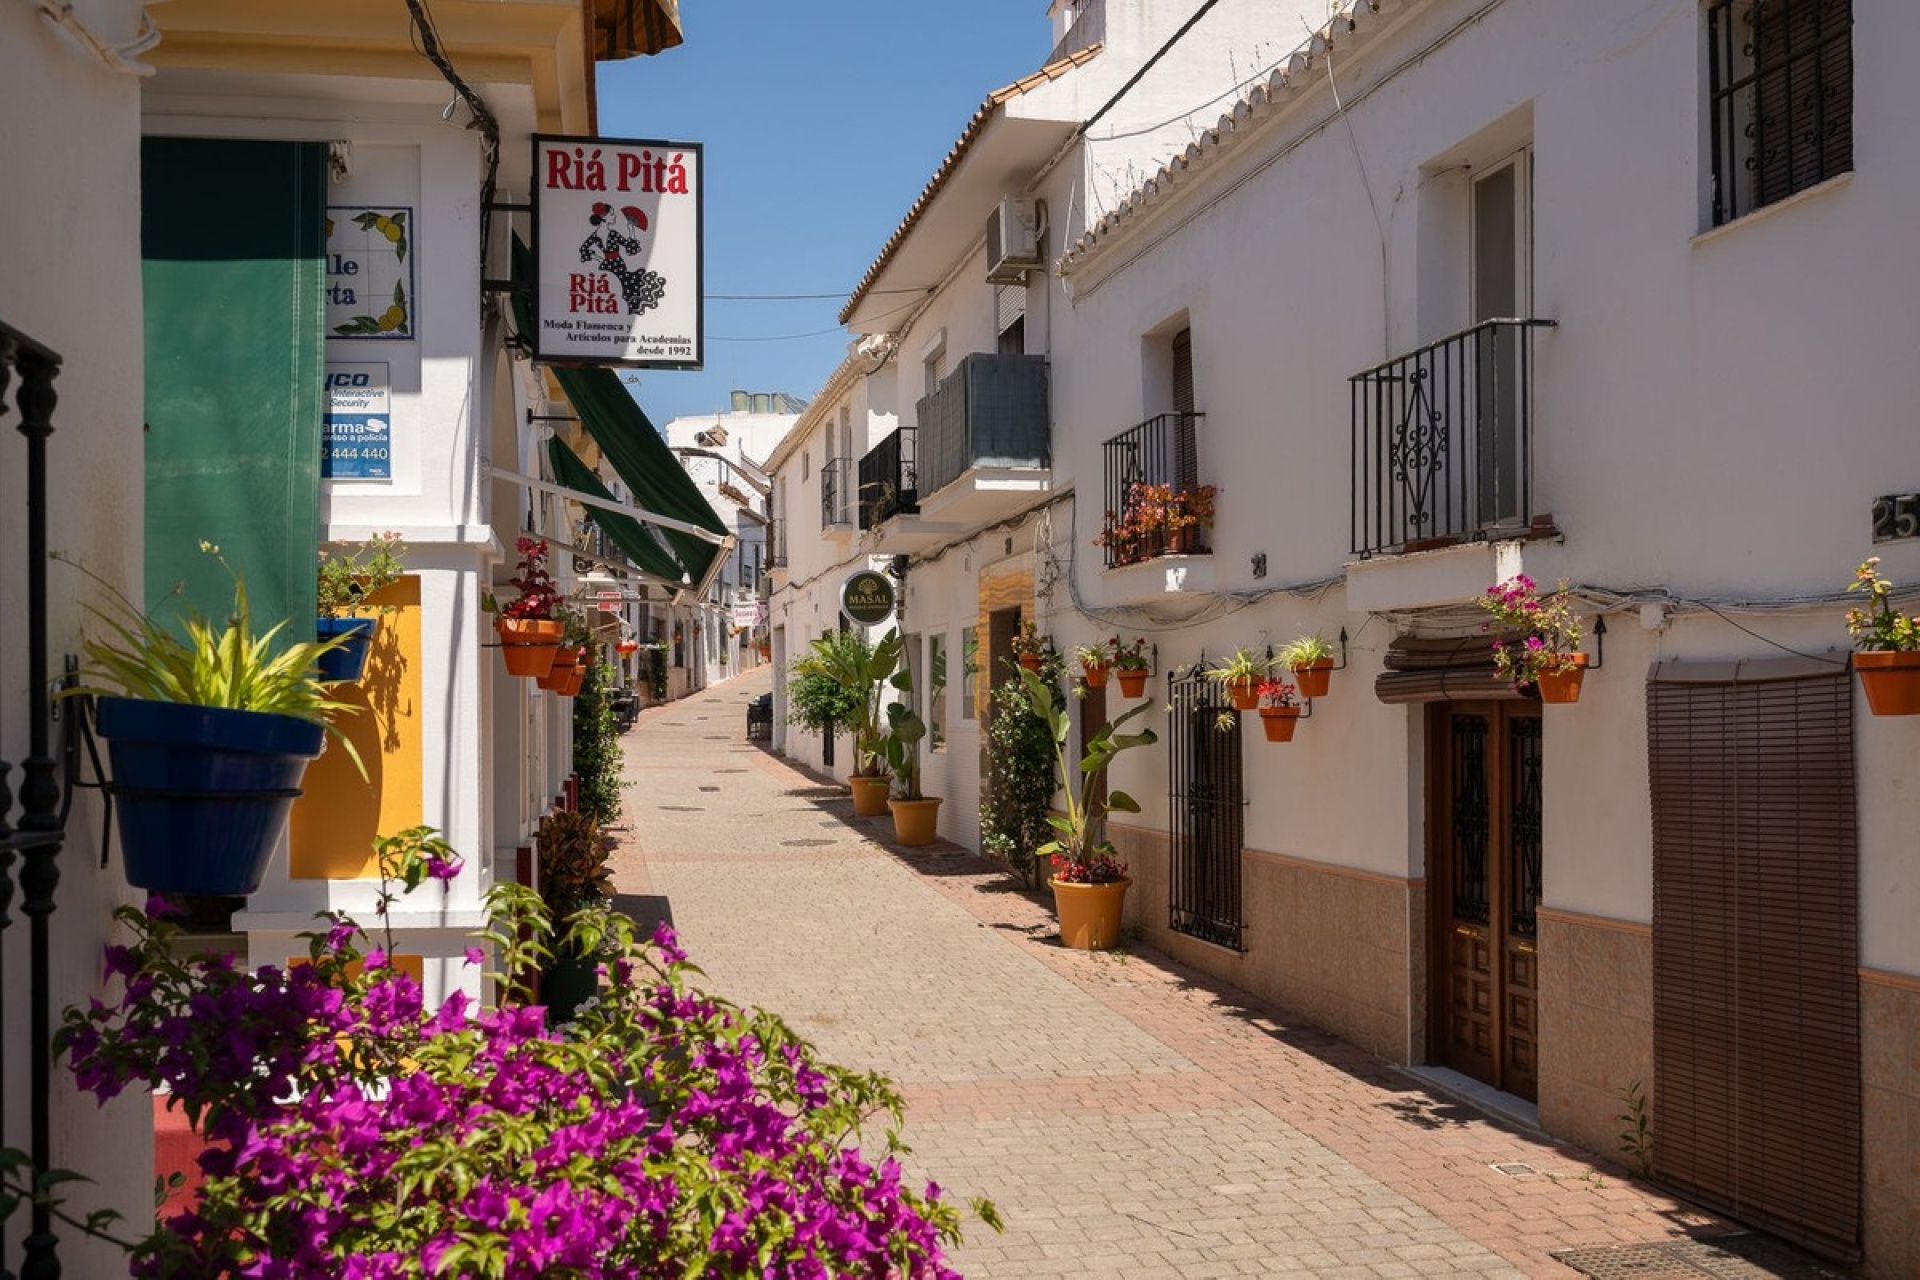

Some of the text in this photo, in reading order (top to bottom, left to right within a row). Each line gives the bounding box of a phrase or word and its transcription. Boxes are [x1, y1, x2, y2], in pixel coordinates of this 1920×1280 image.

[546, 147, 689, 194] Riá Pitá
[569, 272, 610, 293] Riá
[569, 293, 620, 314] Pitá
[543, 319, 632, 334] Moda Flamenca y
[613, 334, 636, 344] para
[639, 334, 692, 344] Academias
[636, 345, 692, 356] desde 1992
[332, 389, 385, 398] Interactive
[330, 398, 370, 408] Security
[332, 447, 358, 460] 444
[361, 447, 388, 460] 440
[1872, 495, 1918, 541] 25
[849, 594, 889, 604] MASAL
